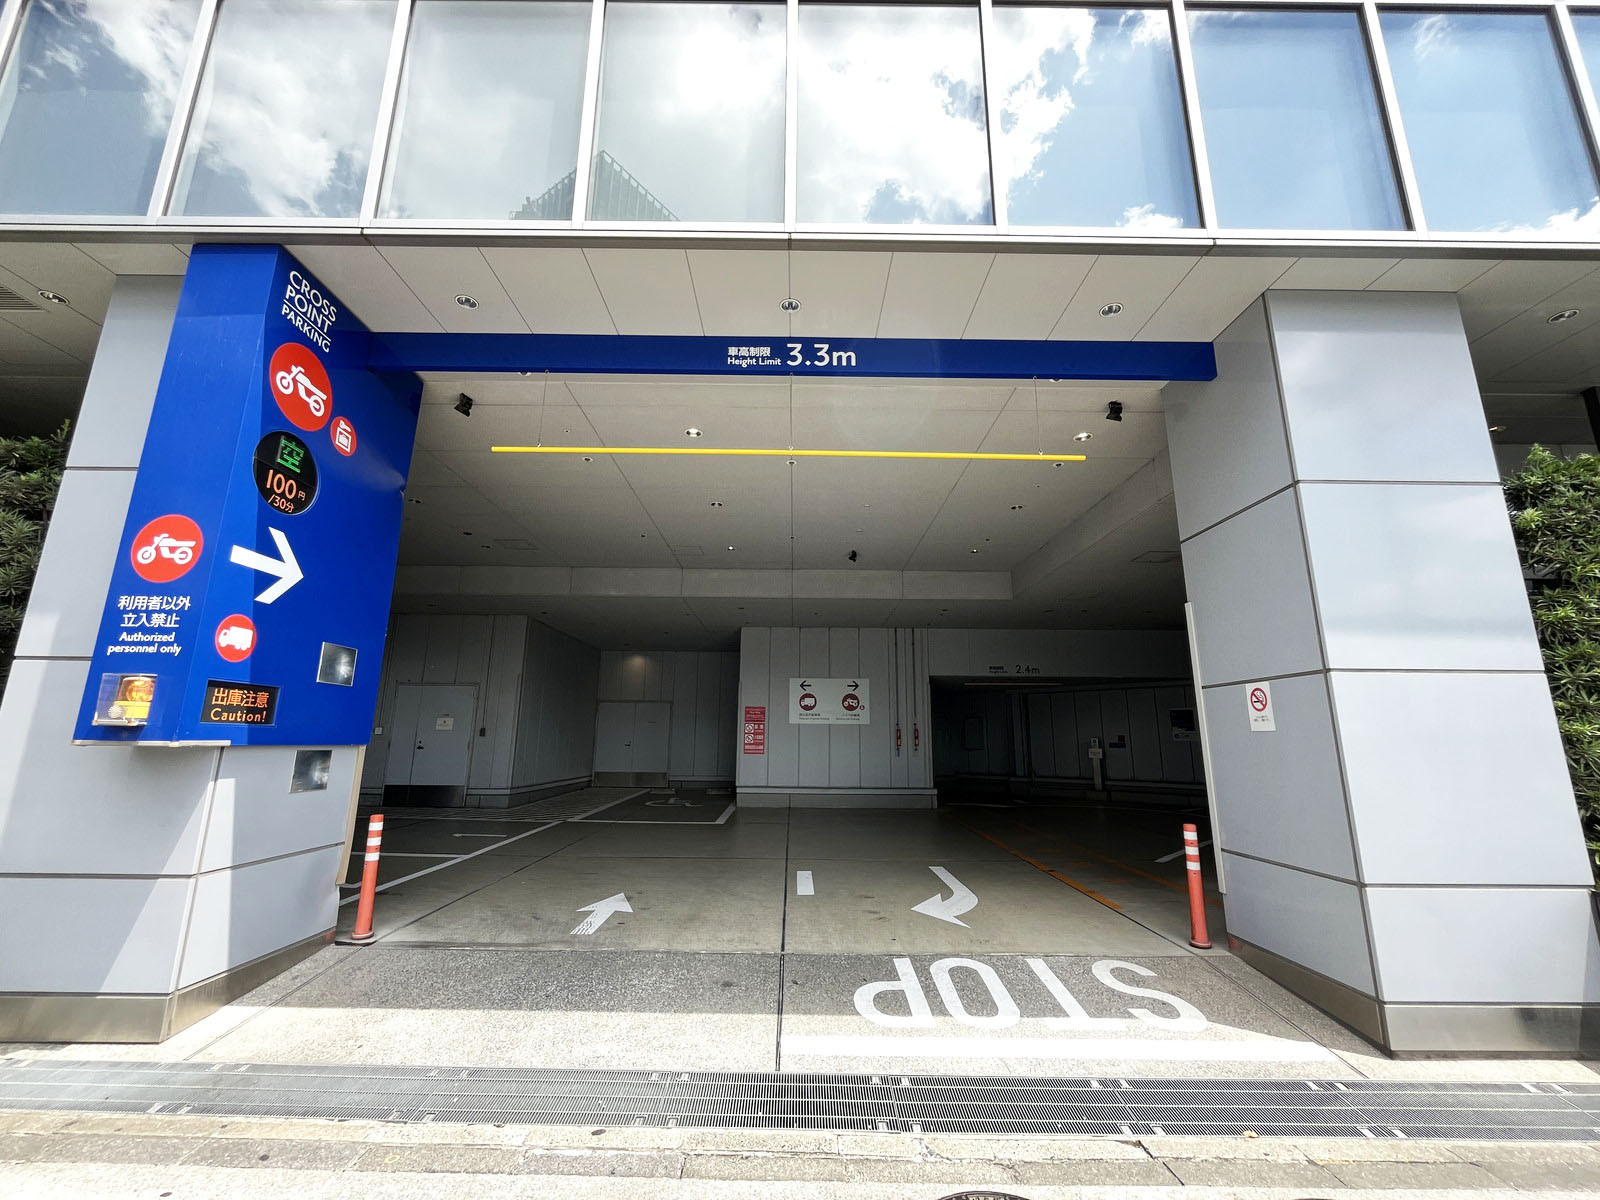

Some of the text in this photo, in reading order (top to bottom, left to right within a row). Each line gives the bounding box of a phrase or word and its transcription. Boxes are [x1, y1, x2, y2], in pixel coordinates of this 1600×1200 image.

[289, 270, 338, 322] CROSS
[285, 284, 333, 333] POINT
[281, 303, 331, 353] PARKING
[727, 346, 771, 357] 車高制限
[786, 343, 857, 367] 3.3m
[727, 357, 782, 368] Height Limit
[277, 441, 305, 474] 空
[267, 494, 295, 513] /30分
[117, 595, 191, 611] 利用者以外
[120, 612, 181, 628] 立入禁止
[118, 631, 176, 642] Authorized
[106, 643, 182, 657] personnel only
[1015, 664, 1040, 674] 2.4m
[211, 687, 270, 708] 出庫注意
[210, 707, 268, 723] Caution!
[853, 957, 1209, 1033] STOP
